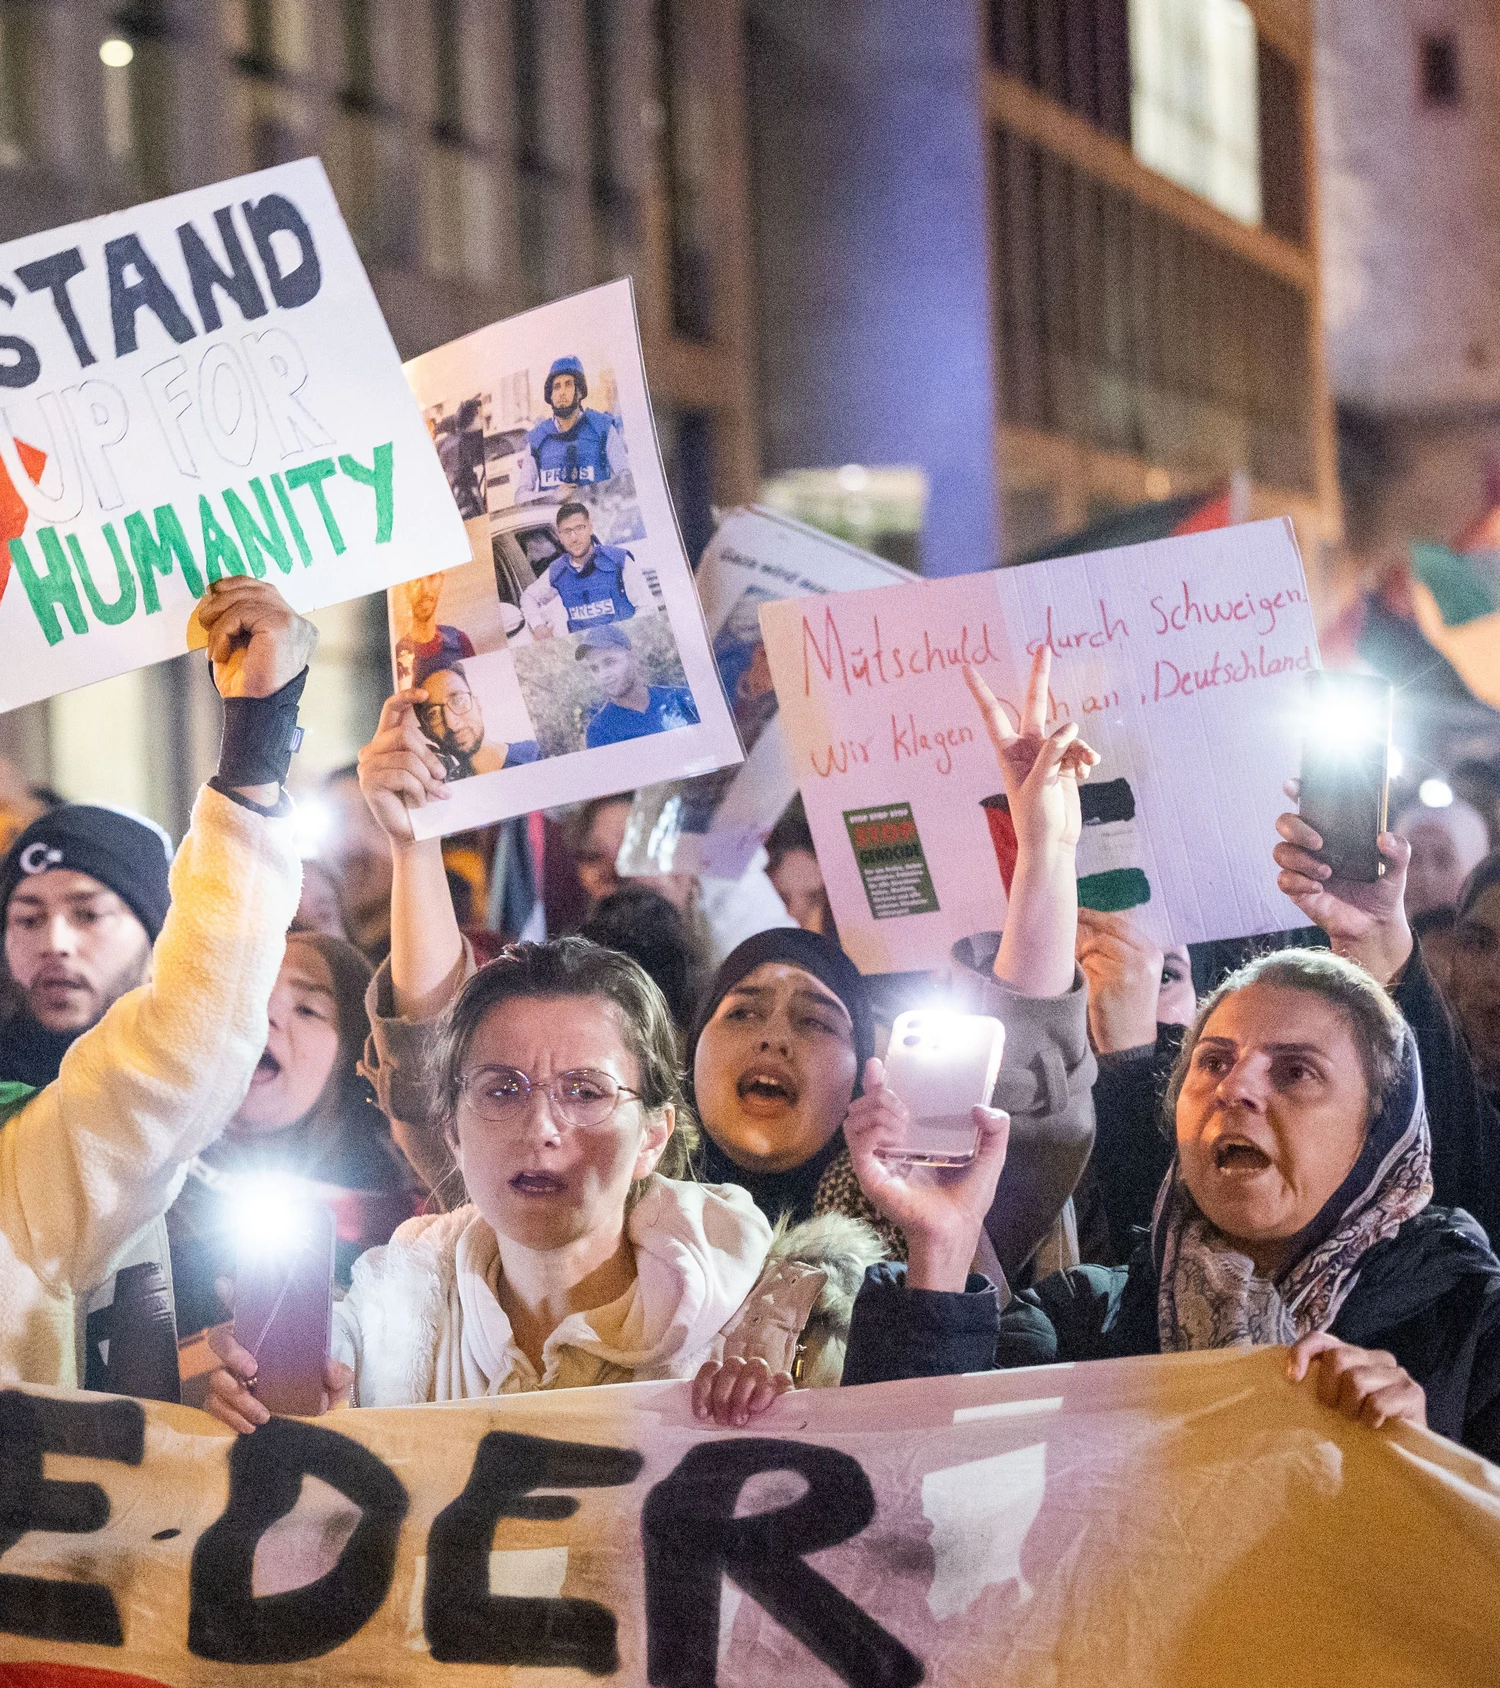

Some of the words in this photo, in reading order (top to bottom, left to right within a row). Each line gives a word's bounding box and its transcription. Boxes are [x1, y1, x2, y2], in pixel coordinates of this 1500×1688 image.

[141, 327, 337, 479] FOR
[545, 464, 590, 483] PRS
[8, 441, 394, 647] HUMANITY
[570, 600, 614, 618] PRESS
[1026, 599, 1129, 659] durch
[854, 821, 916, 849] STOP
